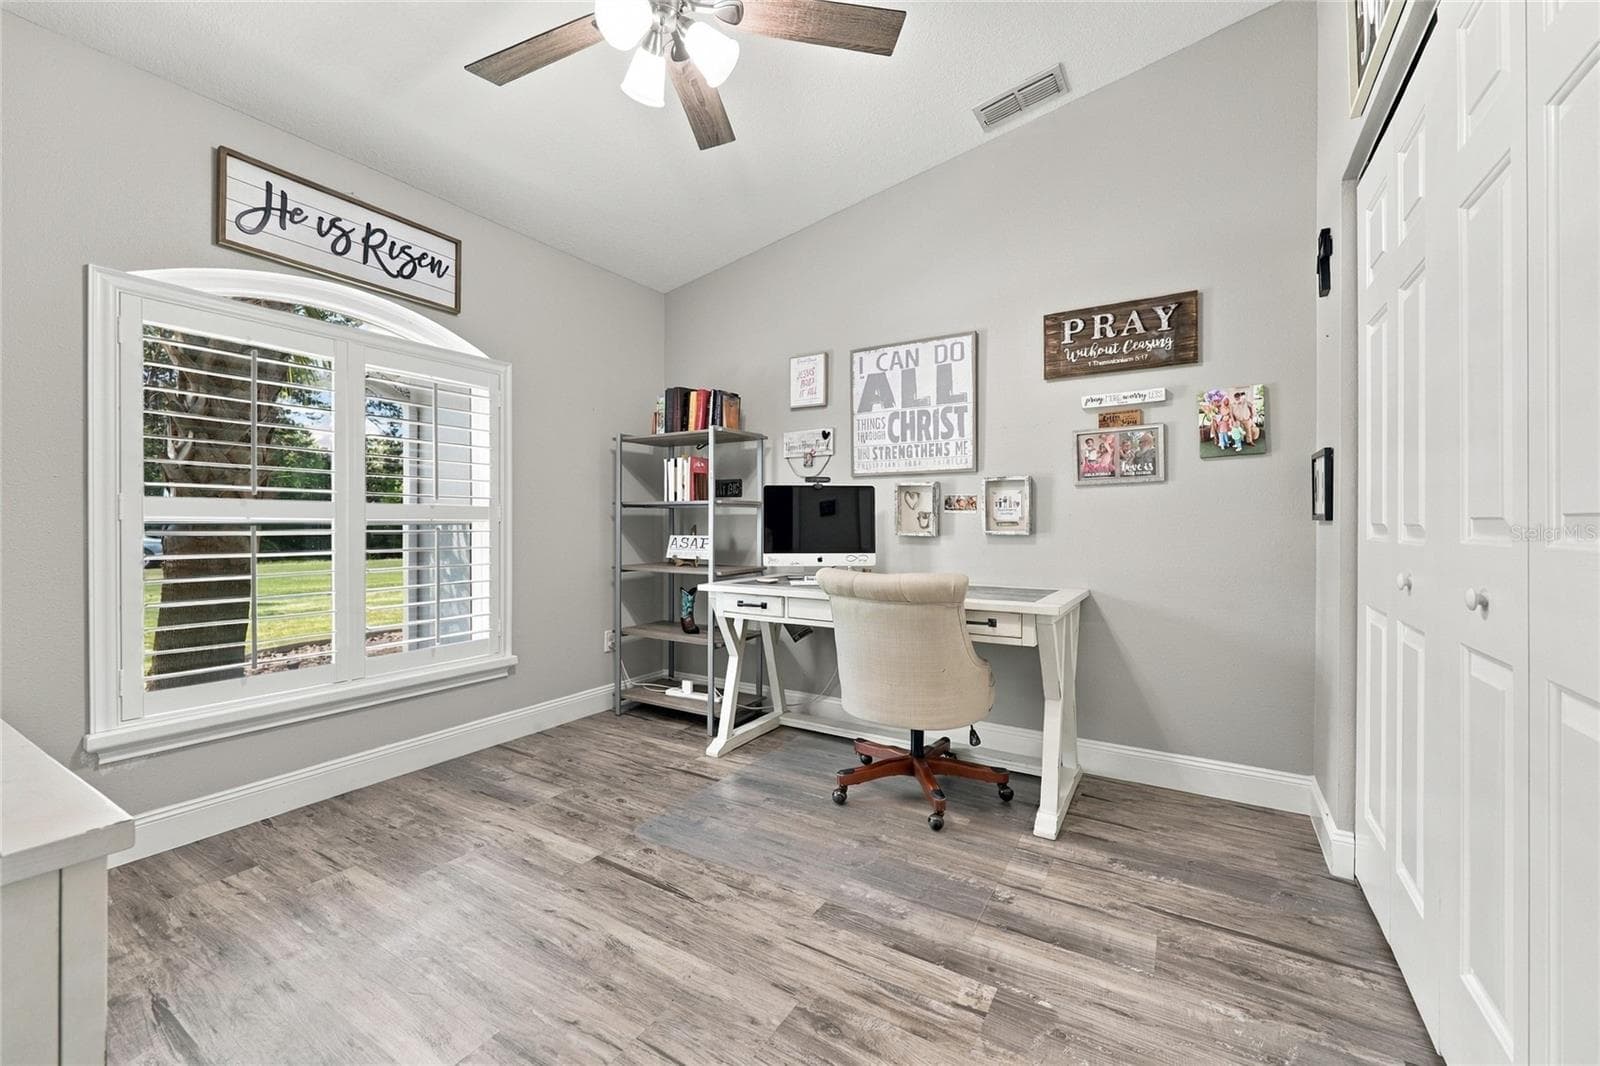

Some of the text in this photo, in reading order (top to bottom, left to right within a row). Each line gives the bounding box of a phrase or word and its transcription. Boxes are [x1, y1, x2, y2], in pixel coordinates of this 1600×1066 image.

[235, 181, 450, 281] He is Risen
[1061, 303, 1178, 345] PRAY
[859, 341, 965, 374] I CAN DO
[1064, 336, 1174, 363] Without Ceasing
[857, 363, 968, 413] ALL
[1084, 396, 1104, 406] pray
[1122, 392, 1147, 401] worry
[856, 416, 886, 431] THINGS
[857, 430, 886, 444] THROUGH
[887, 405, 968, 444] CHRIST
[872, 442, 950, 461] STRENGTHENS
[955, 441, 968, 455] ME
